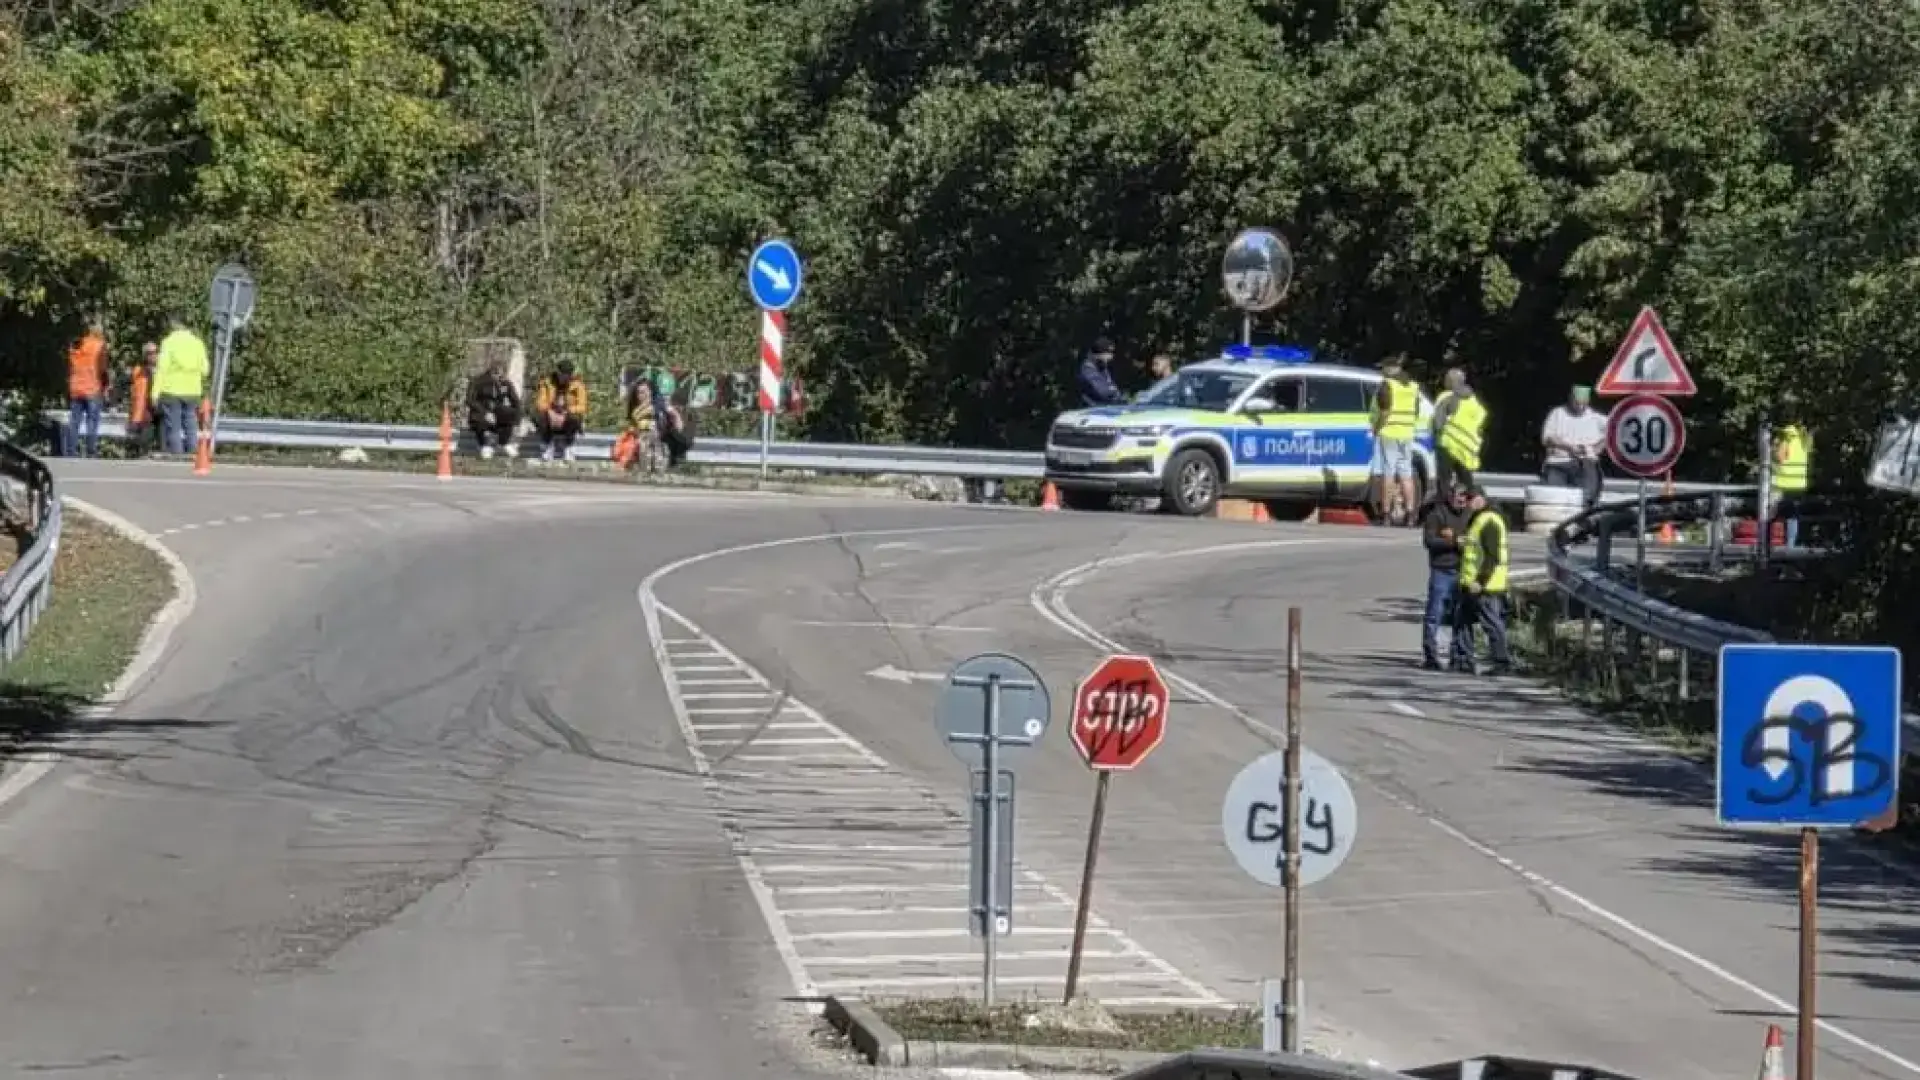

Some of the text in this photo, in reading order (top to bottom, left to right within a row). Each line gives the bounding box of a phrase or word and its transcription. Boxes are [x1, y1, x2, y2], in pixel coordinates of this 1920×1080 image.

[1264, 437, 1346, 456] ПОЛИЦИЯ
[1623, 415, 1667, 455] 30
[1083, 690, 1160, 733] STOP
